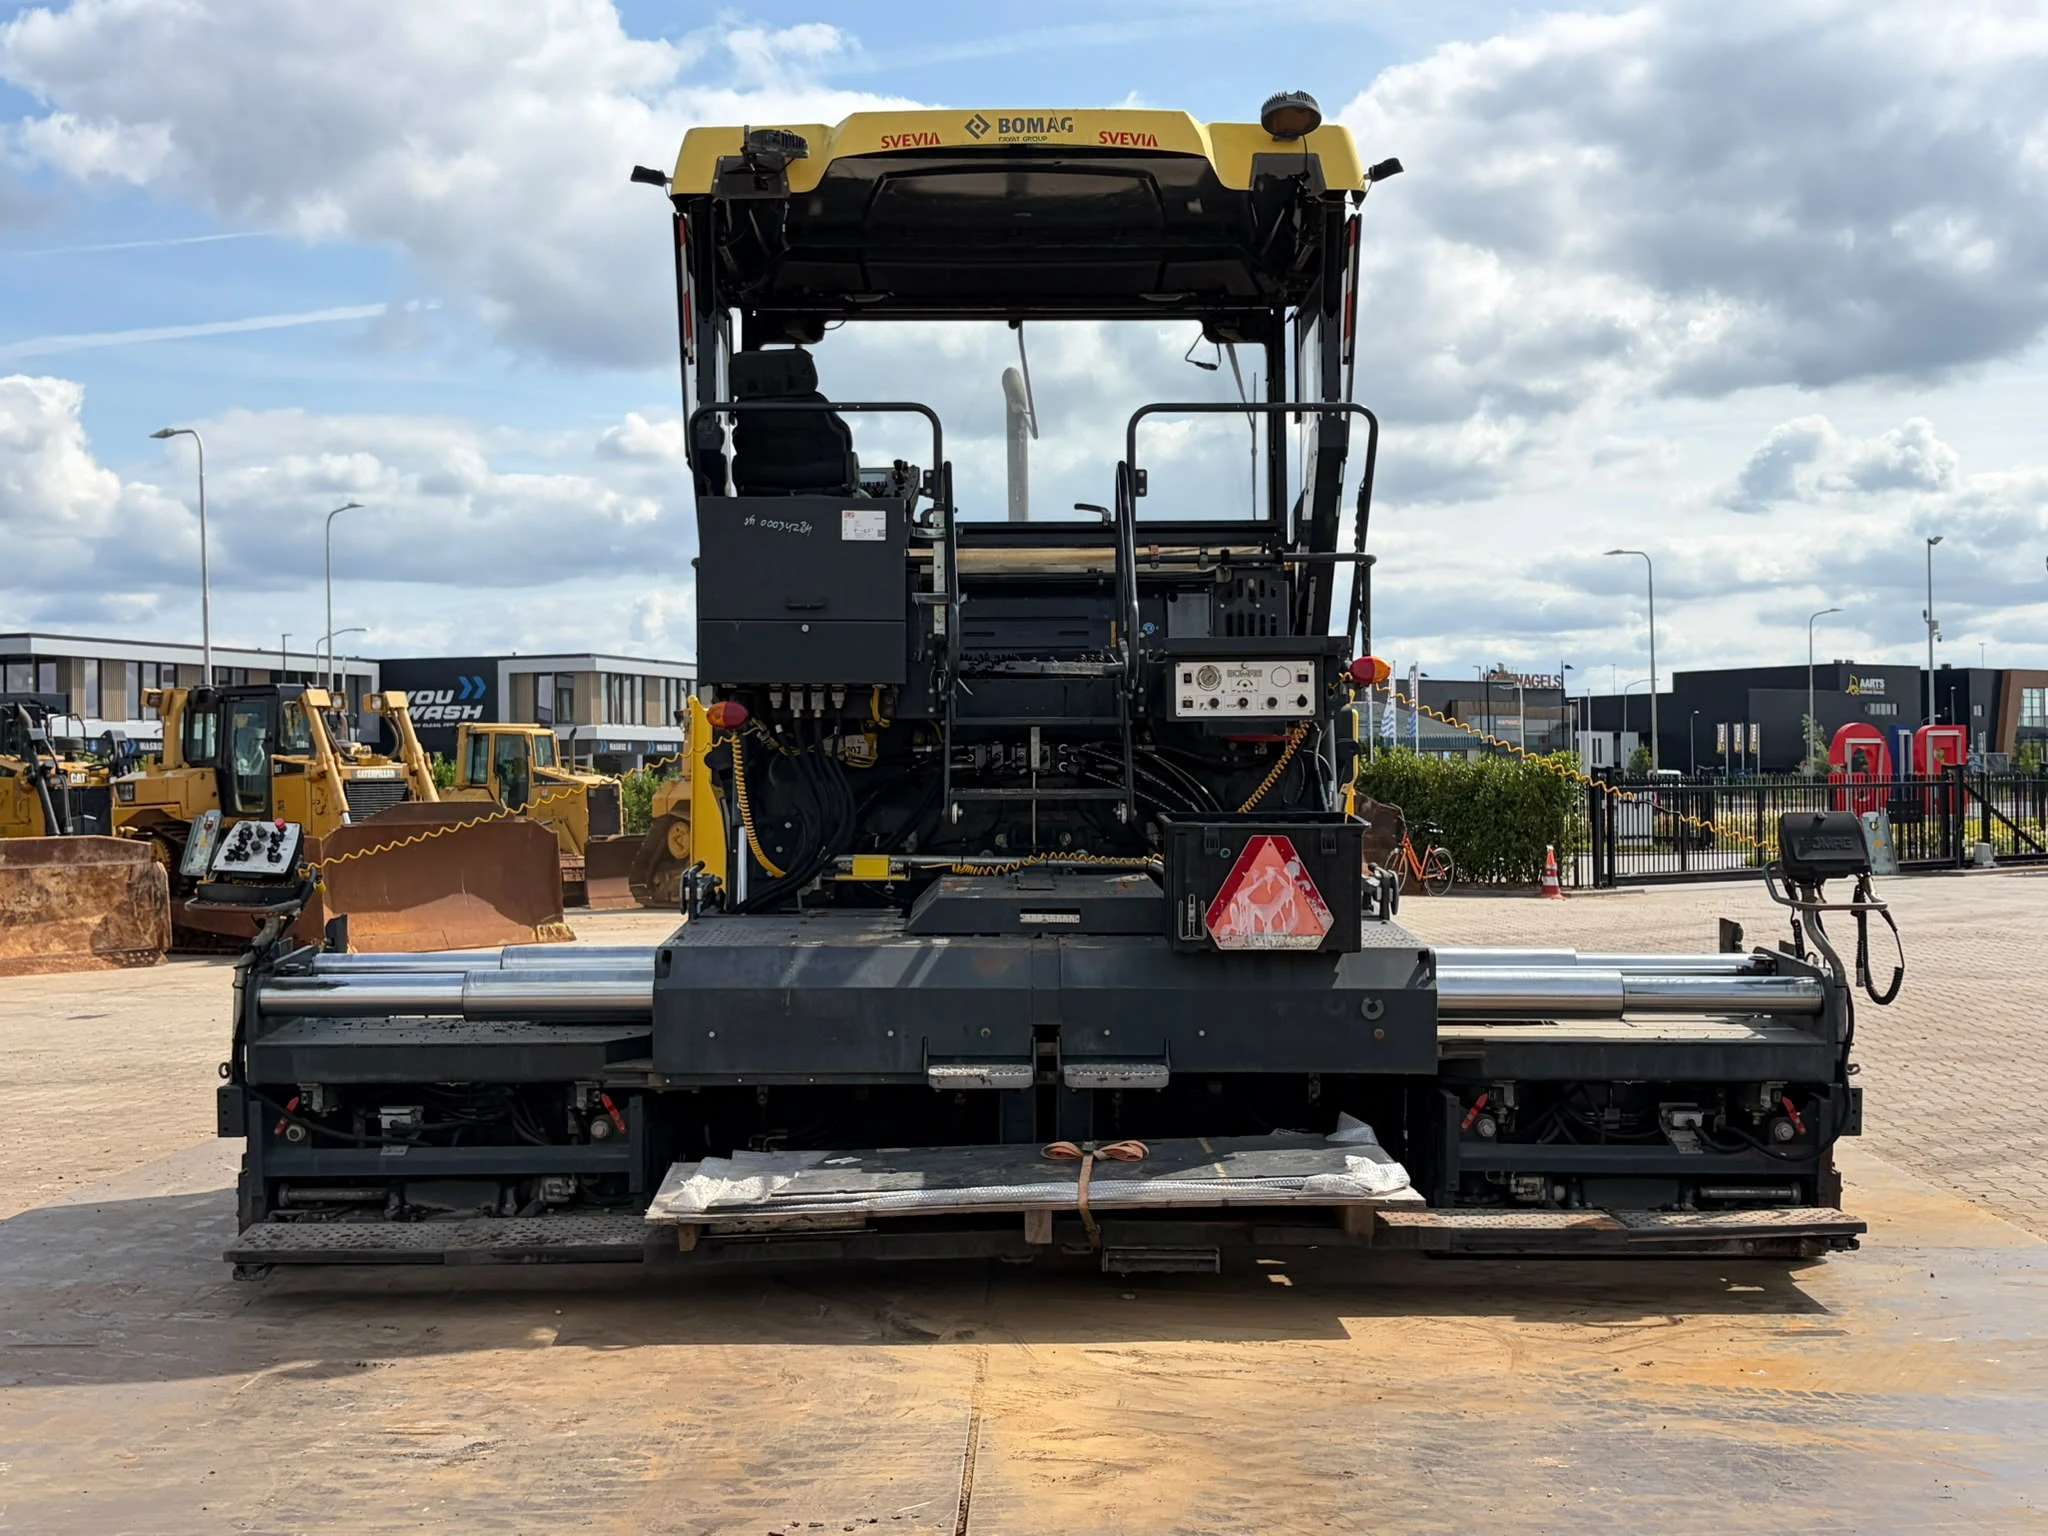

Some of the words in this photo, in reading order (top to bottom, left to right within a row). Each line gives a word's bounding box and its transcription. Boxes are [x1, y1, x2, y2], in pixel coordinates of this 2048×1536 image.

[998, 116, 1074, 134] BOMAG
[881, 132, 942, 149] SVEVIA
[1099, 131, 1158, 148] SVEVIA
[70, 773, 86, 783] CAT
